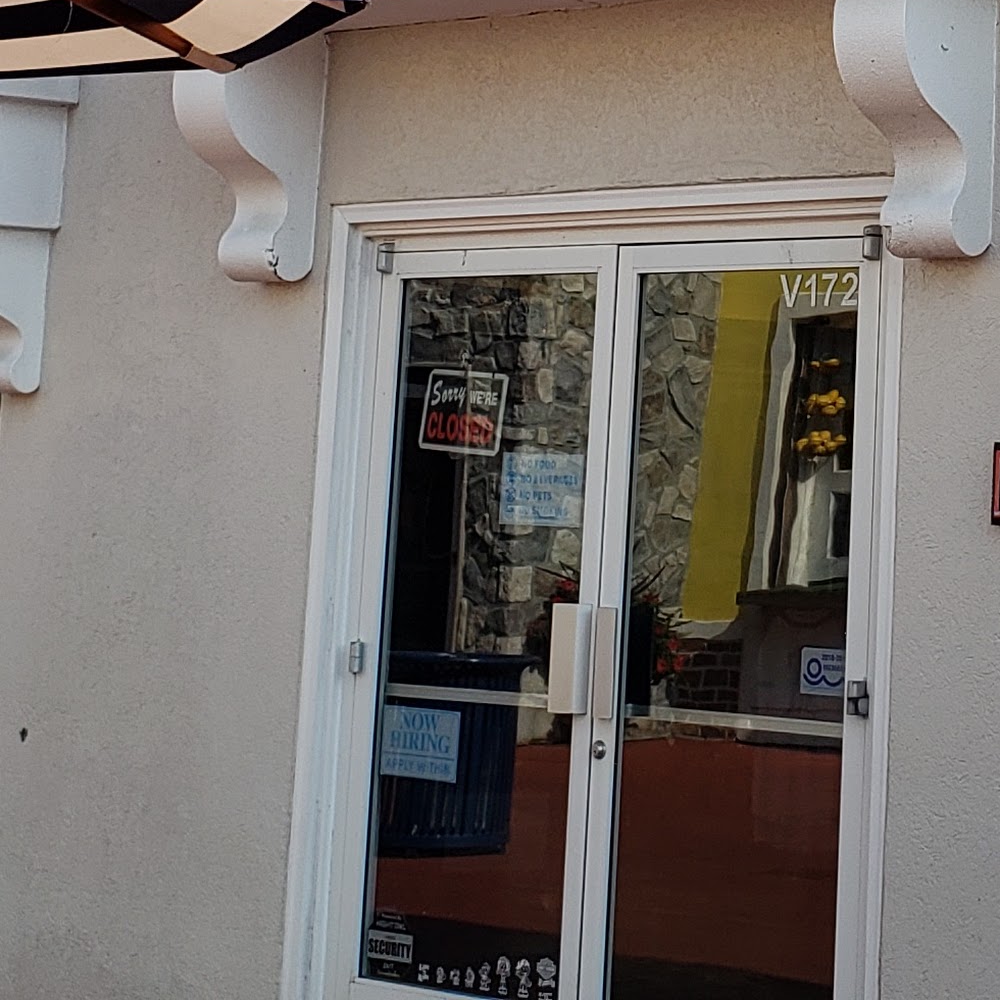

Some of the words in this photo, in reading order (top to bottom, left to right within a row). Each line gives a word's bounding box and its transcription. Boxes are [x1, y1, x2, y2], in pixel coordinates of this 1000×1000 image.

[780, 272, 858, 308] V172
[431, 379, 467, 408] Sorry
[426, 411, 494, 445] CLOSED
[400, 711, 440, 731] NOW
[391, 730, 450, 754] HIRING
[368, 938, 412, 959] SECURITY
